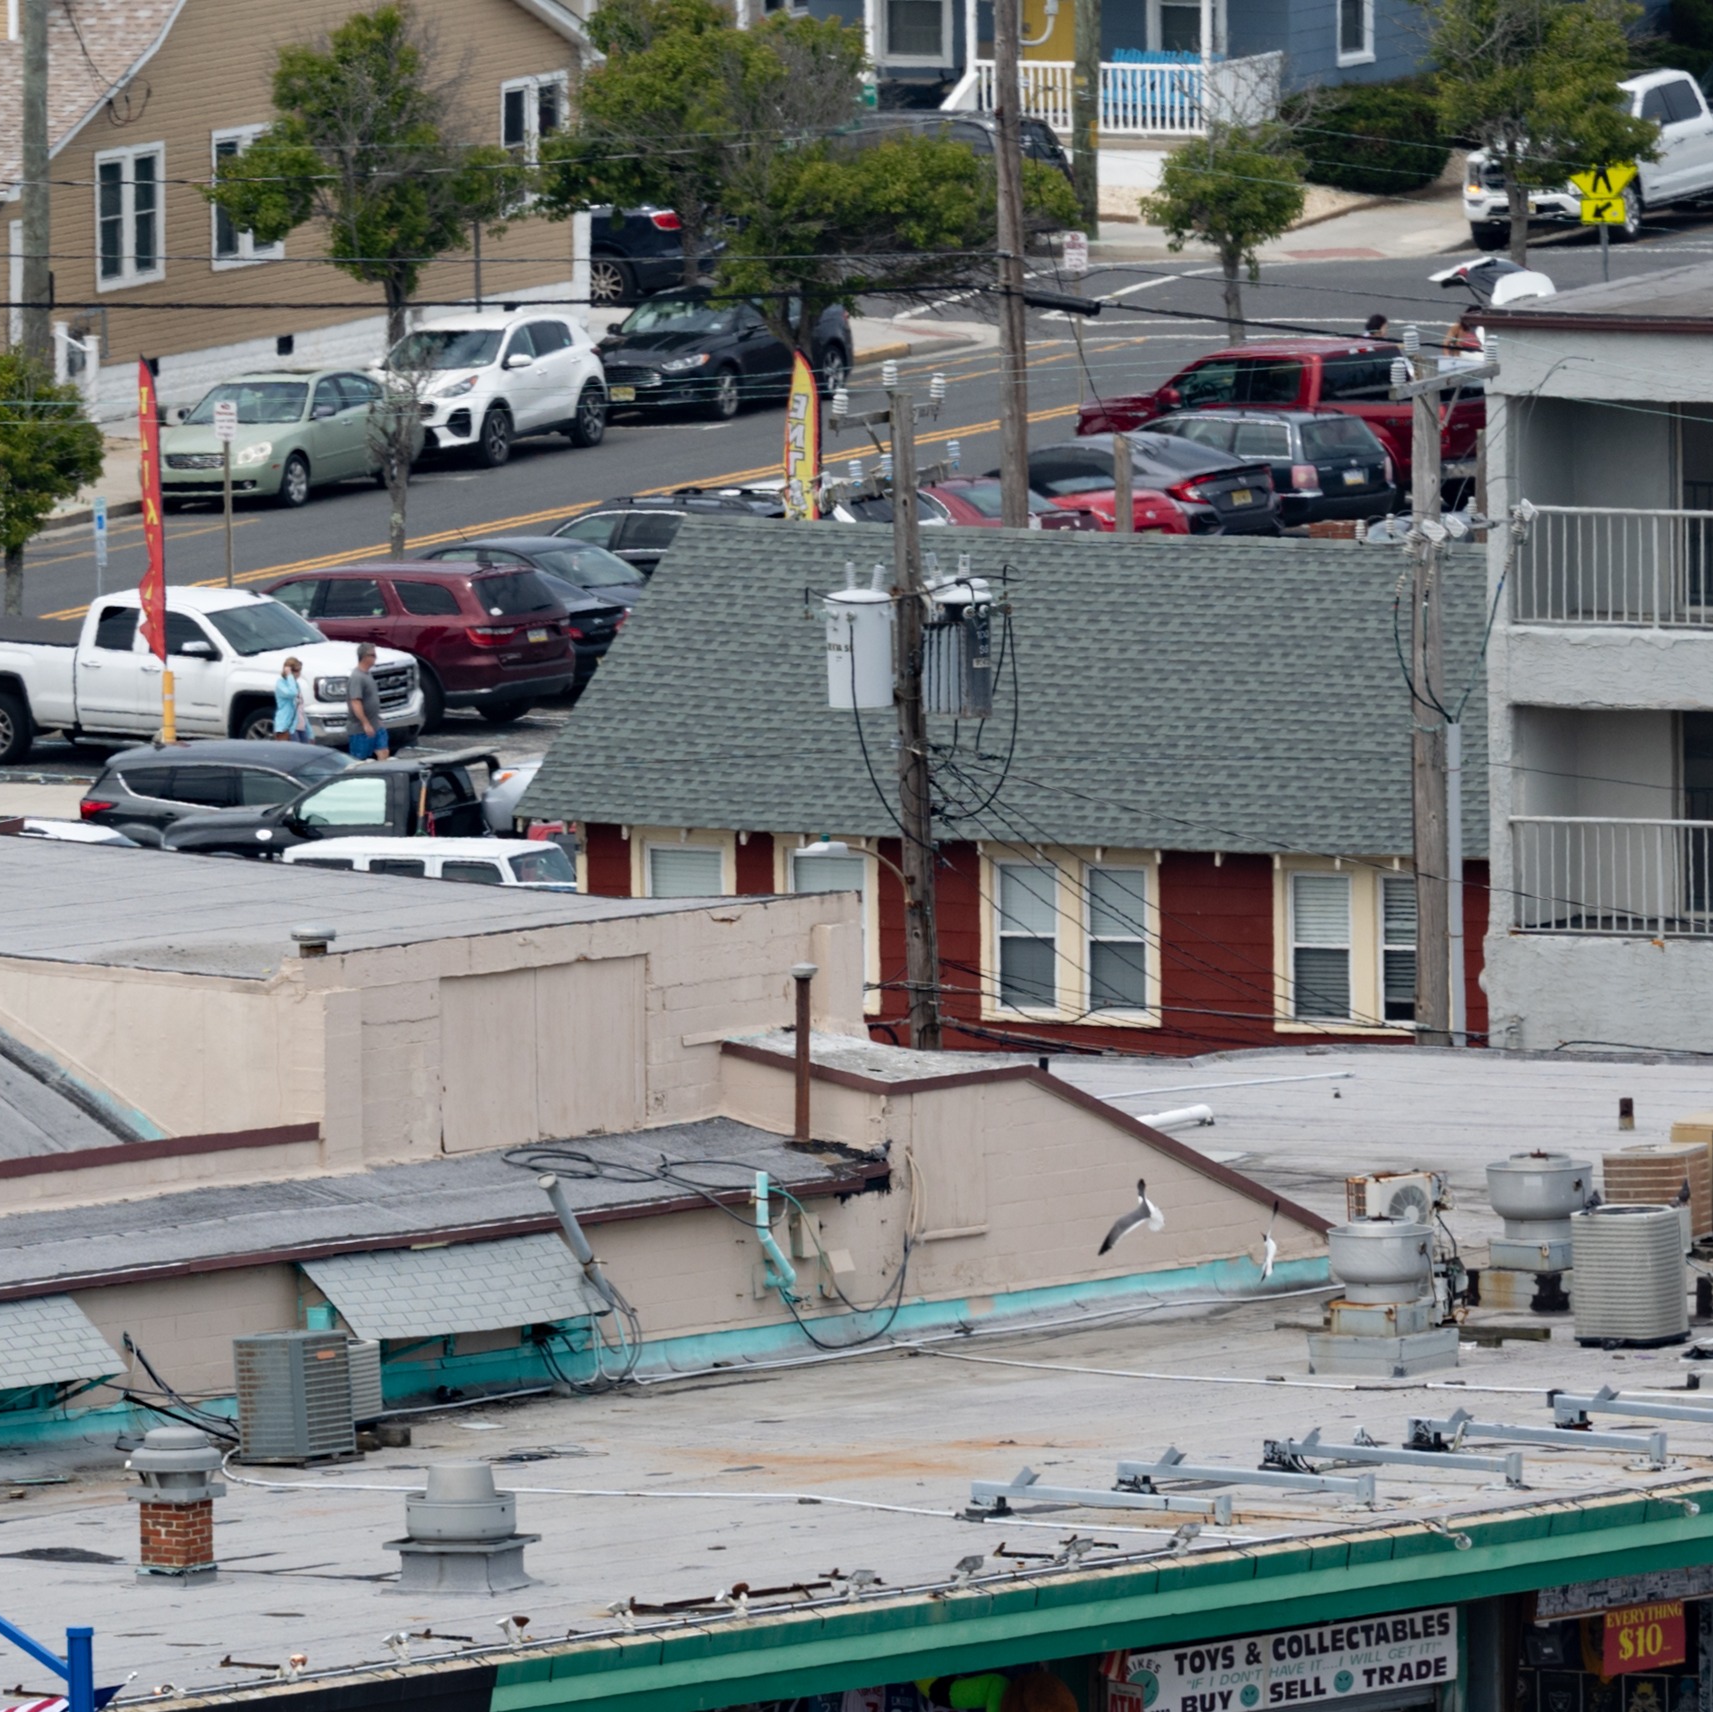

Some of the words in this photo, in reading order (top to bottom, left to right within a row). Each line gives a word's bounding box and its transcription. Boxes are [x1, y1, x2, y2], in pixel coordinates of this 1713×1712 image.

[1606, 1601, 1683, 1629] EVERYTHING
[1174, 1643, 1236, 1676] TOYS
[1245, 1642, 1263, 1667] &
[1272, 1612, 1451, 1662] COLLECTABLES
[1619, 1622, 1663, 1661] $10
[1219, 1669, 1263, 1686] DON'T
[1268, 1663, 1306, 1678] HAVE
[1350, 1650, 1385, 1667] WILL
[1389, 1645, 1416, 1660] GET
[1269, 1676, 1327, 1703] SELL
[1362, 1656, 1448, 1688] TRADE
